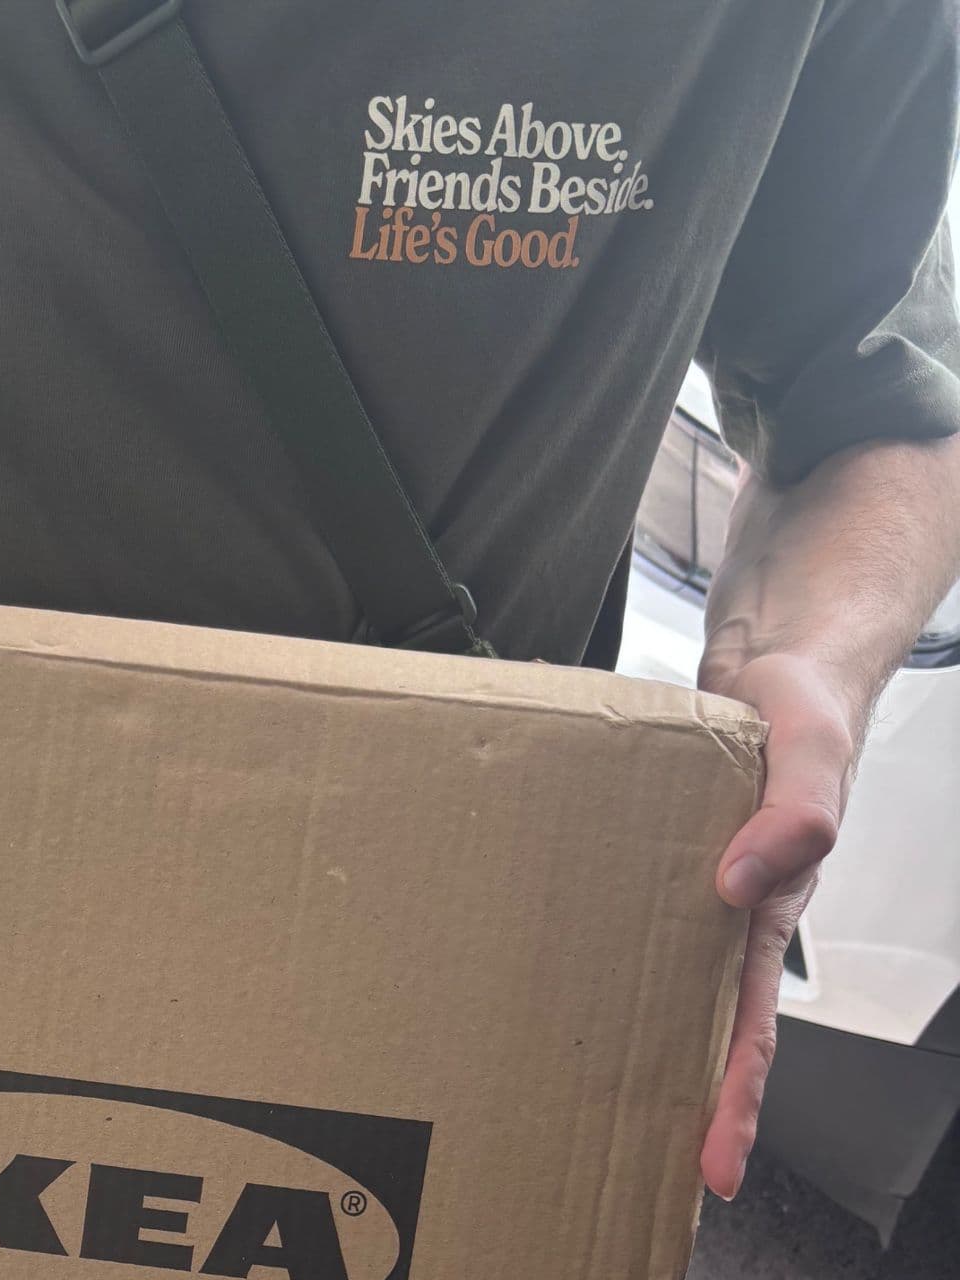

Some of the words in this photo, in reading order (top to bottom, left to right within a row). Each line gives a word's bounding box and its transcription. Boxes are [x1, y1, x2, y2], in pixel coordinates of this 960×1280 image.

[364, 95, 481, 156] Skies
[485, 102, 628, 161] Above.
[358, 151, 522, 213] Friends
[528, 160, 654, 215] Beside.
[349, 206, 458, 264] Life's
[465, 214, 580, 268] Good.
